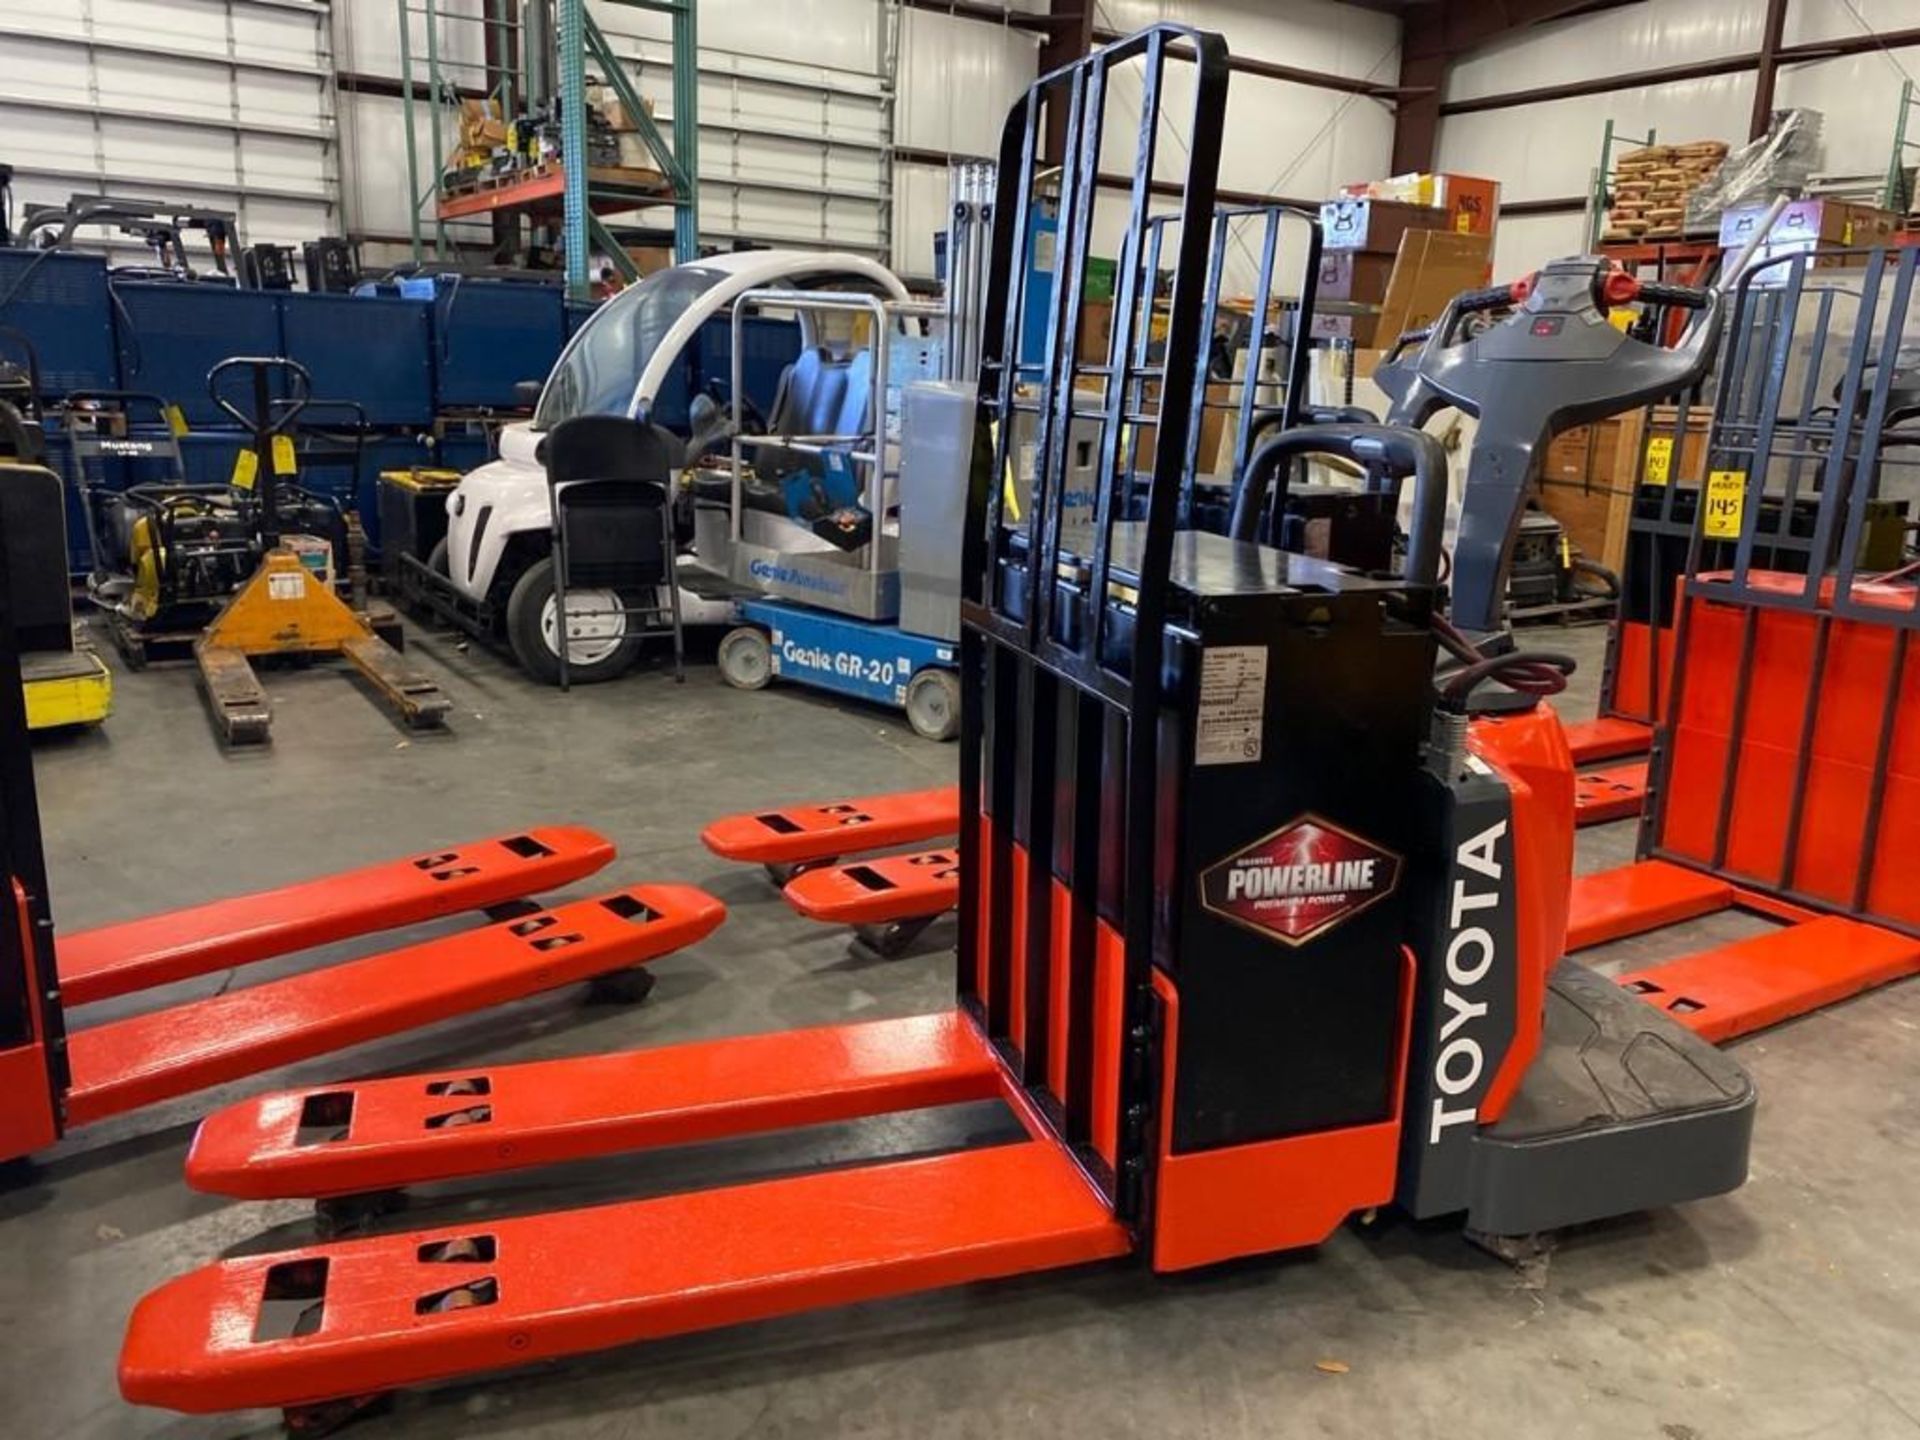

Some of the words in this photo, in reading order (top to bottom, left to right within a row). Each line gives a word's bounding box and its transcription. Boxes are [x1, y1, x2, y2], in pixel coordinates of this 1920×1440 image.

[100, 440, 153, 451] Mustang
[1709, 498, 1739, 516] 145
[782, 639, 832, 672] Genie
[834, 651, 895, 686] GR-20
[1227, 859, 1375, 900] POWERLINE
[1430, 819, 1507, 1144] TOYOTA
